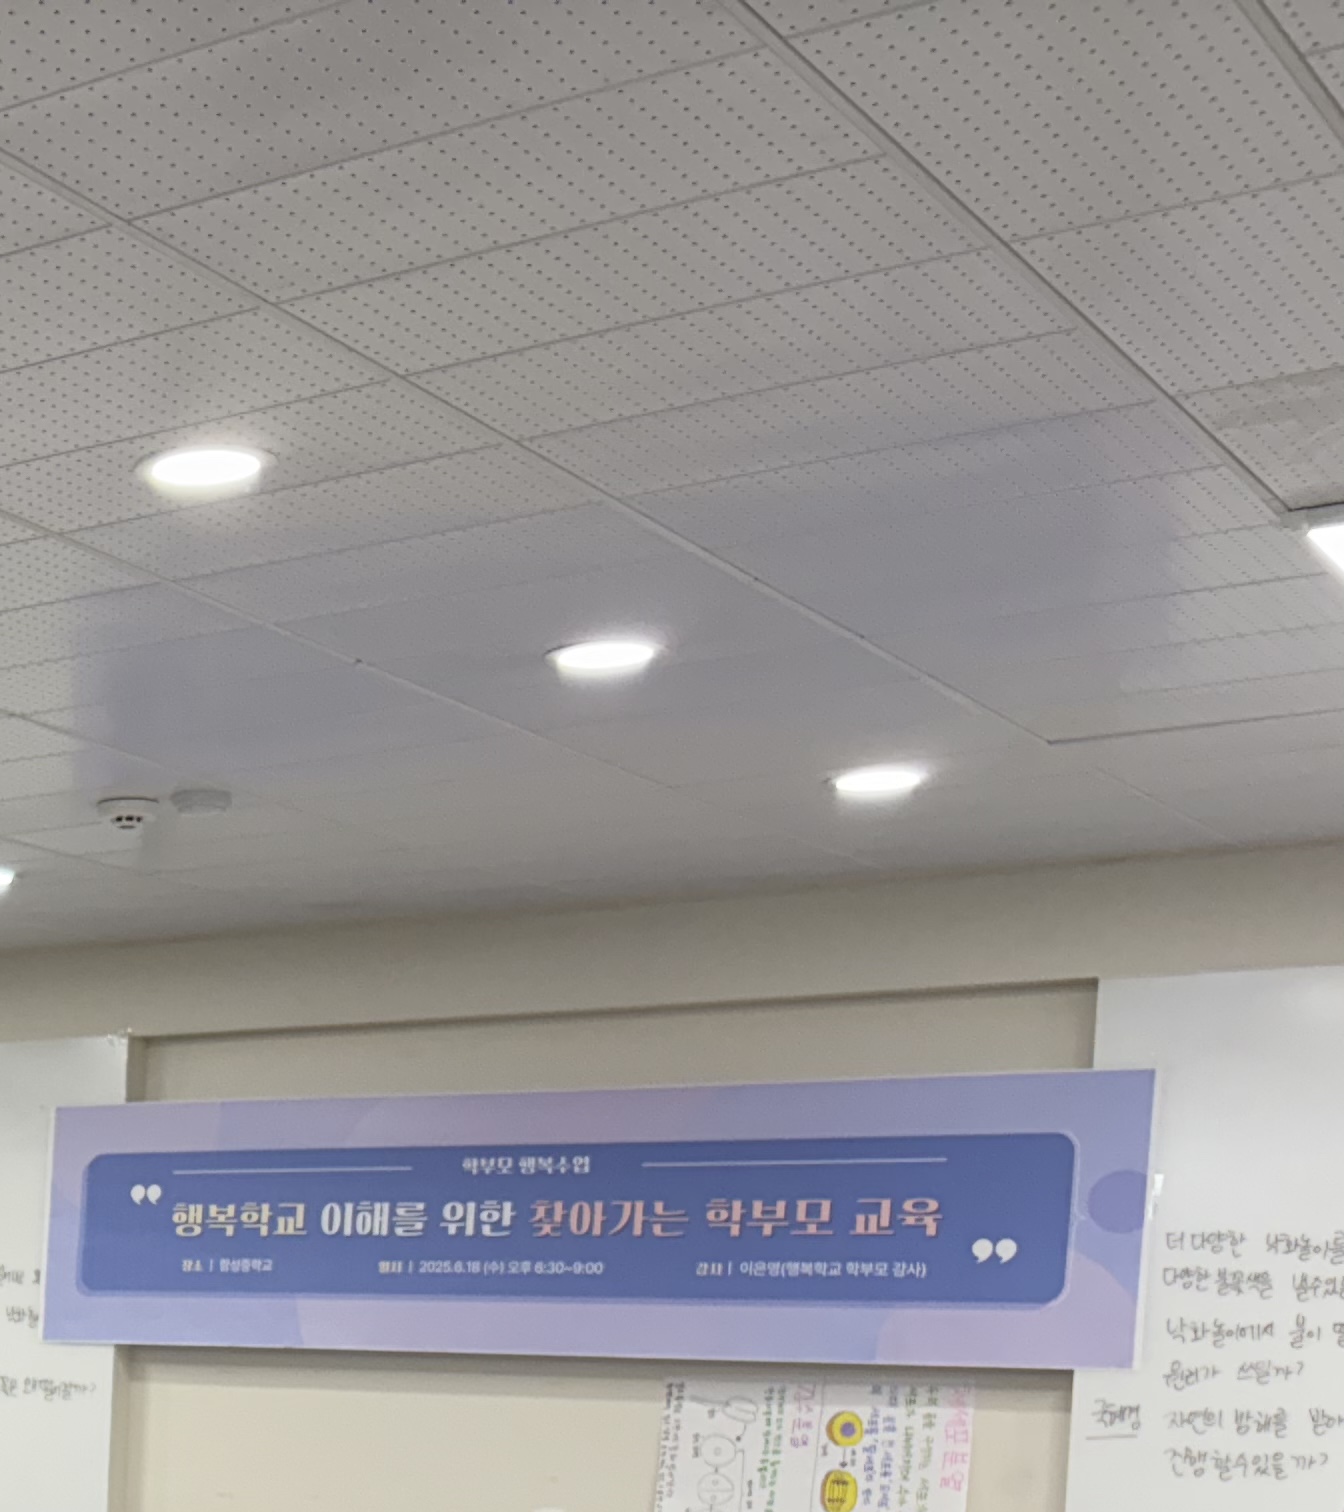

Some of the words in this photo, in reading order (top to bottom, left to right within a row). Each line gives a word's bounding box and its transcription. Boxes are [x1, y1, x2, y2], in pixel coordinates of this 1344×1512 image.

[462, 1156, 513, 1176] 학부모
[172, 1202, 308, 1238] 행복학교
[320, 1201, 428, 1237] 이해를
[440, 1200, 516, 1237] 위한
[530, 1200, 689, 1238] 찾아가는
[706, 1198, 835, 1237] 학부모
[849, 1198, 943, 1237] 교육
[1165, 1232, 1184, 1251] 더
[1191, 1230, 1246, 1258] 다양한
